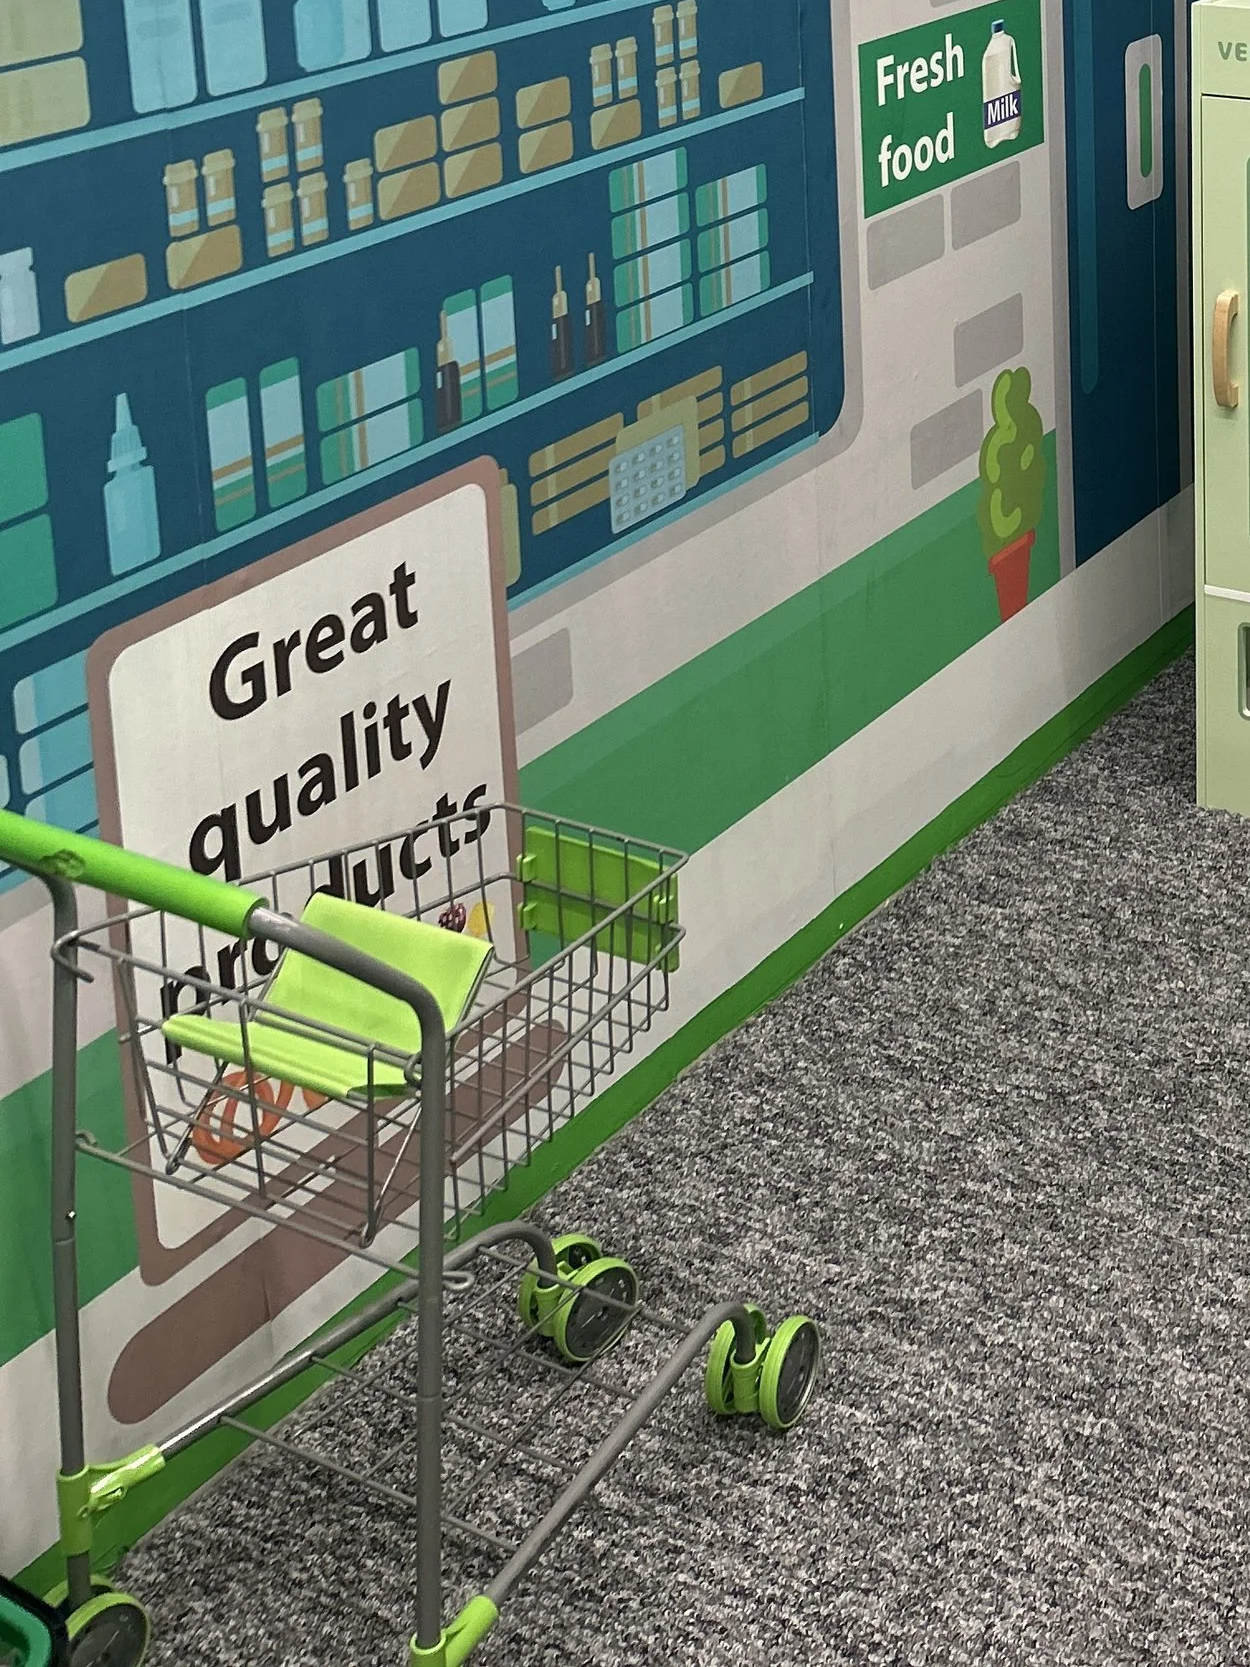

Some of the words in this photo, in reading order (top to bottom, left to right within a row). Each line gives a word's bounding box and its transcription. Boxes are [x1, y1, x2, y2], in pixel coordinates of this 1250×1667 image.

[877, 33, 964, 107] Fresh
[986, 93, 1018, 125] Milk
[878, 112, 954, 187] food
[208, 561, 419, 721] Great
[189, 679, 451, 882] quality
